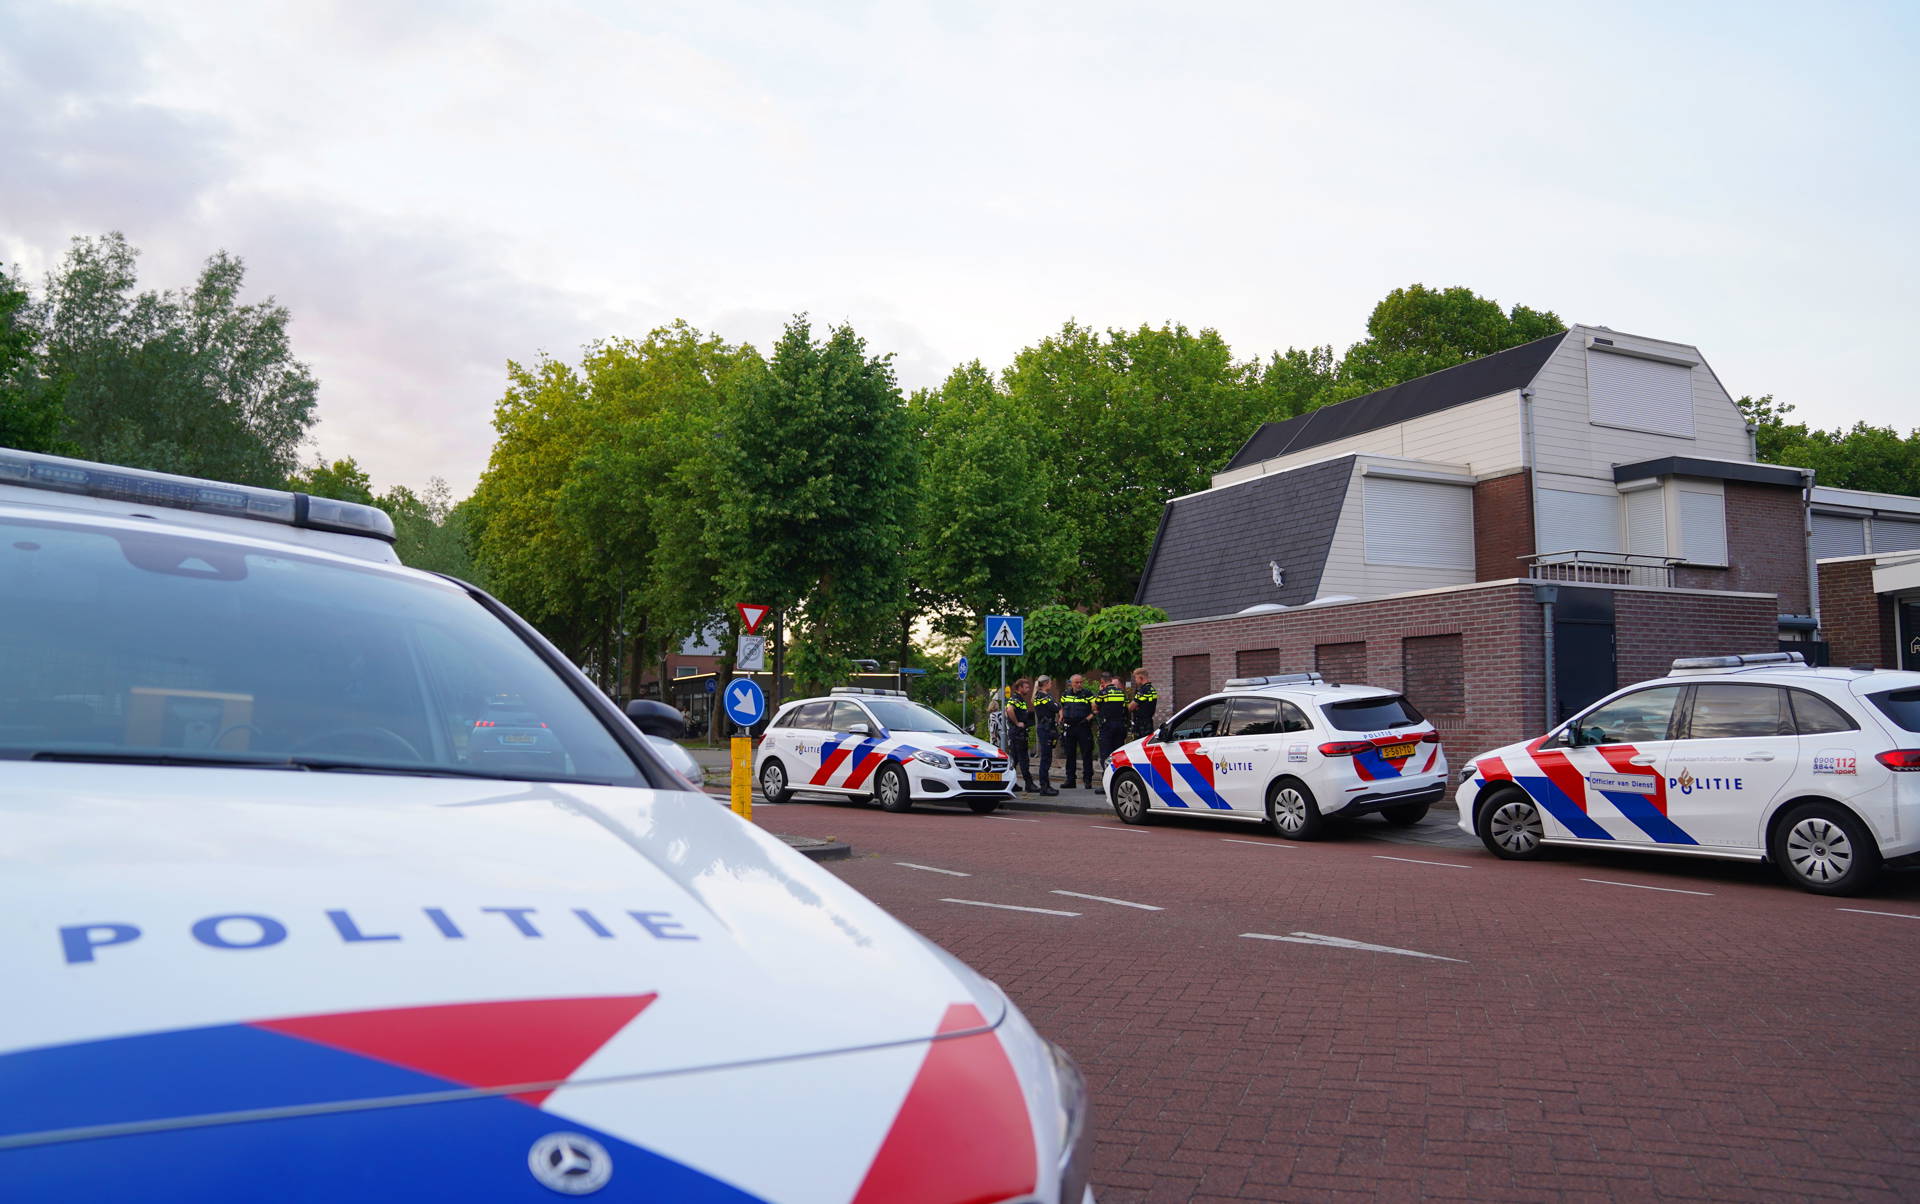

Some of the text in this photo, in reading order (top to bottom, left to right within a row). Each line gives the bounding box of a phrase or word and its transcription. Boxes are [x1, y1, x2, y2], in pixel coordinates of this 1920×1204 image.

[1363, 730, 1393, 740] POLITIE
[795, 745, 820, 755] POLITIE
[1215, 761, 1254, 775] POLITIE
[1834, 757, 1857, 768] 112
[1591, 777, 1615, 785] Officier
[1631, 780, 1654, 788] Dienst
[1669, 777, 1744, 795] POLITIE
[59, 907, 700, 965] POLITIE
